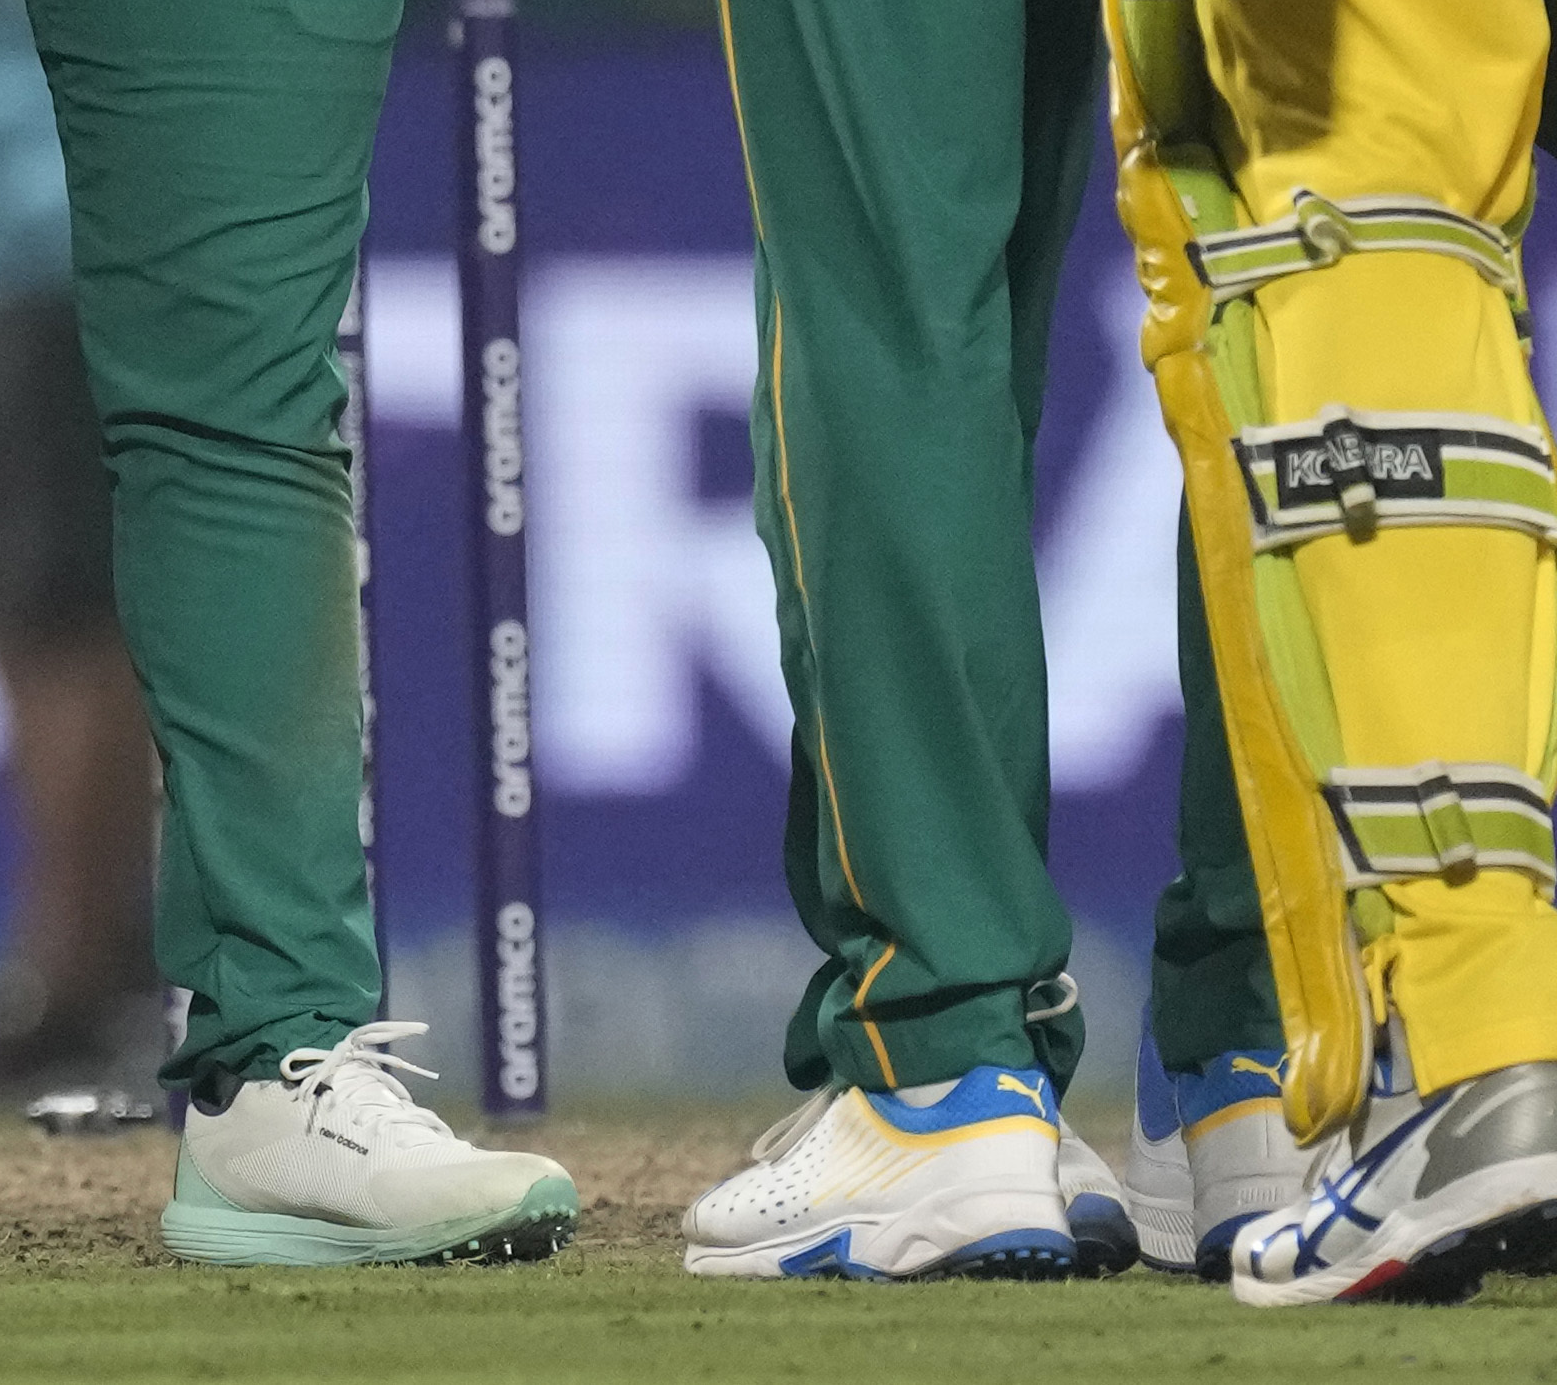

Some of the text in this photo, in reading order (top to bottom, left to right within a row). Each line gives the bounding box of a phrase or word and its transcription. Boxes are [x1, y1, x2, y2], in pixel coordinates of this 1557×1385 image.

[473, 54, 516, 255] aramco
[483, 337, 525, 537] aramco
[490, 619, 533, 818] aramco
[496, 901, 539, 1100] aramco
